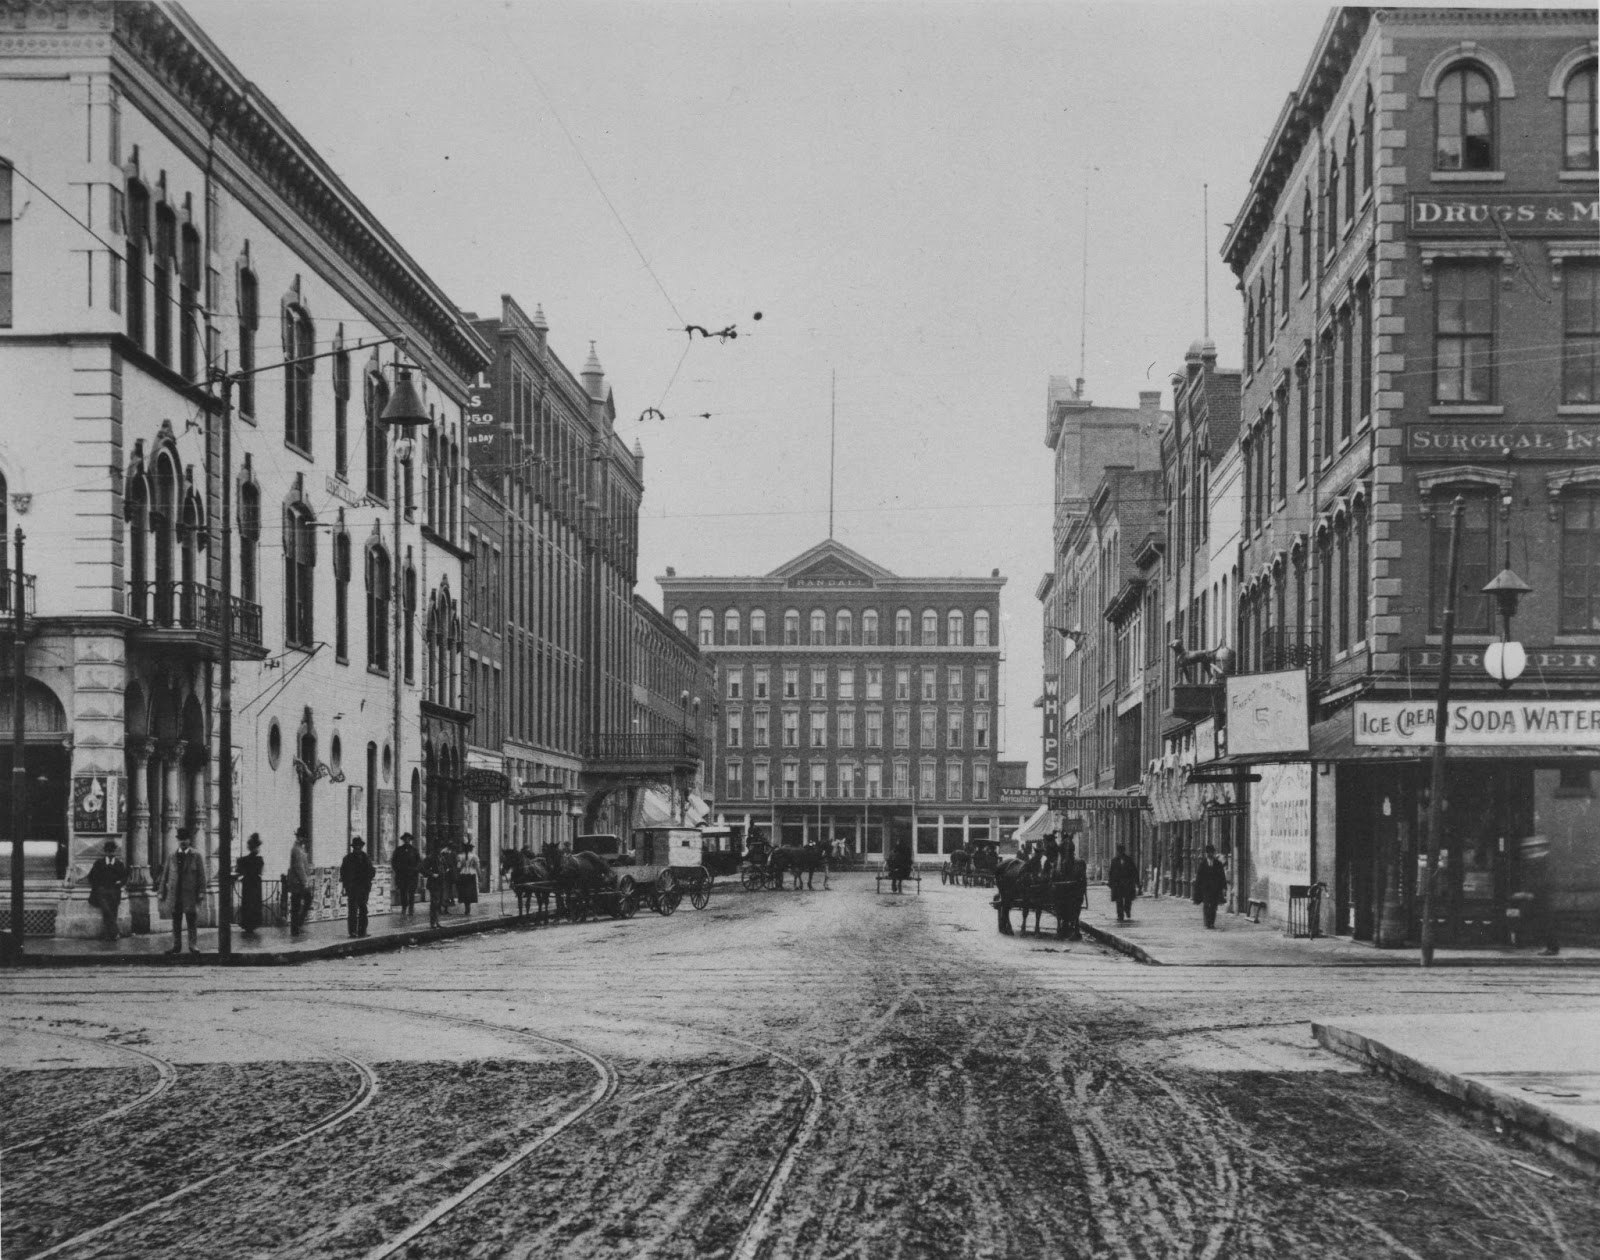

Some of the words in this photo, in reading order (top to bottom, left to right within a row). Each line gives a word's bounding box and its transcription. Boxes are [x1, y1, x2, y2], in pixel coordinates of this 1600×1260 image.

[1416, 202, 1536, 222] DRUGS
[1545, 206, 1564, 221] &
[1413, 431, 1553, 450] SURGICAL
[1045, 681, 1058, 772] WHIPS
[1361, 712, 1391, 734] ICE
[1396, 708, 1448, 737] CREA
[1454, 705, 1515, 730] SODA
[1522, 706, 1600, 730] WATER
